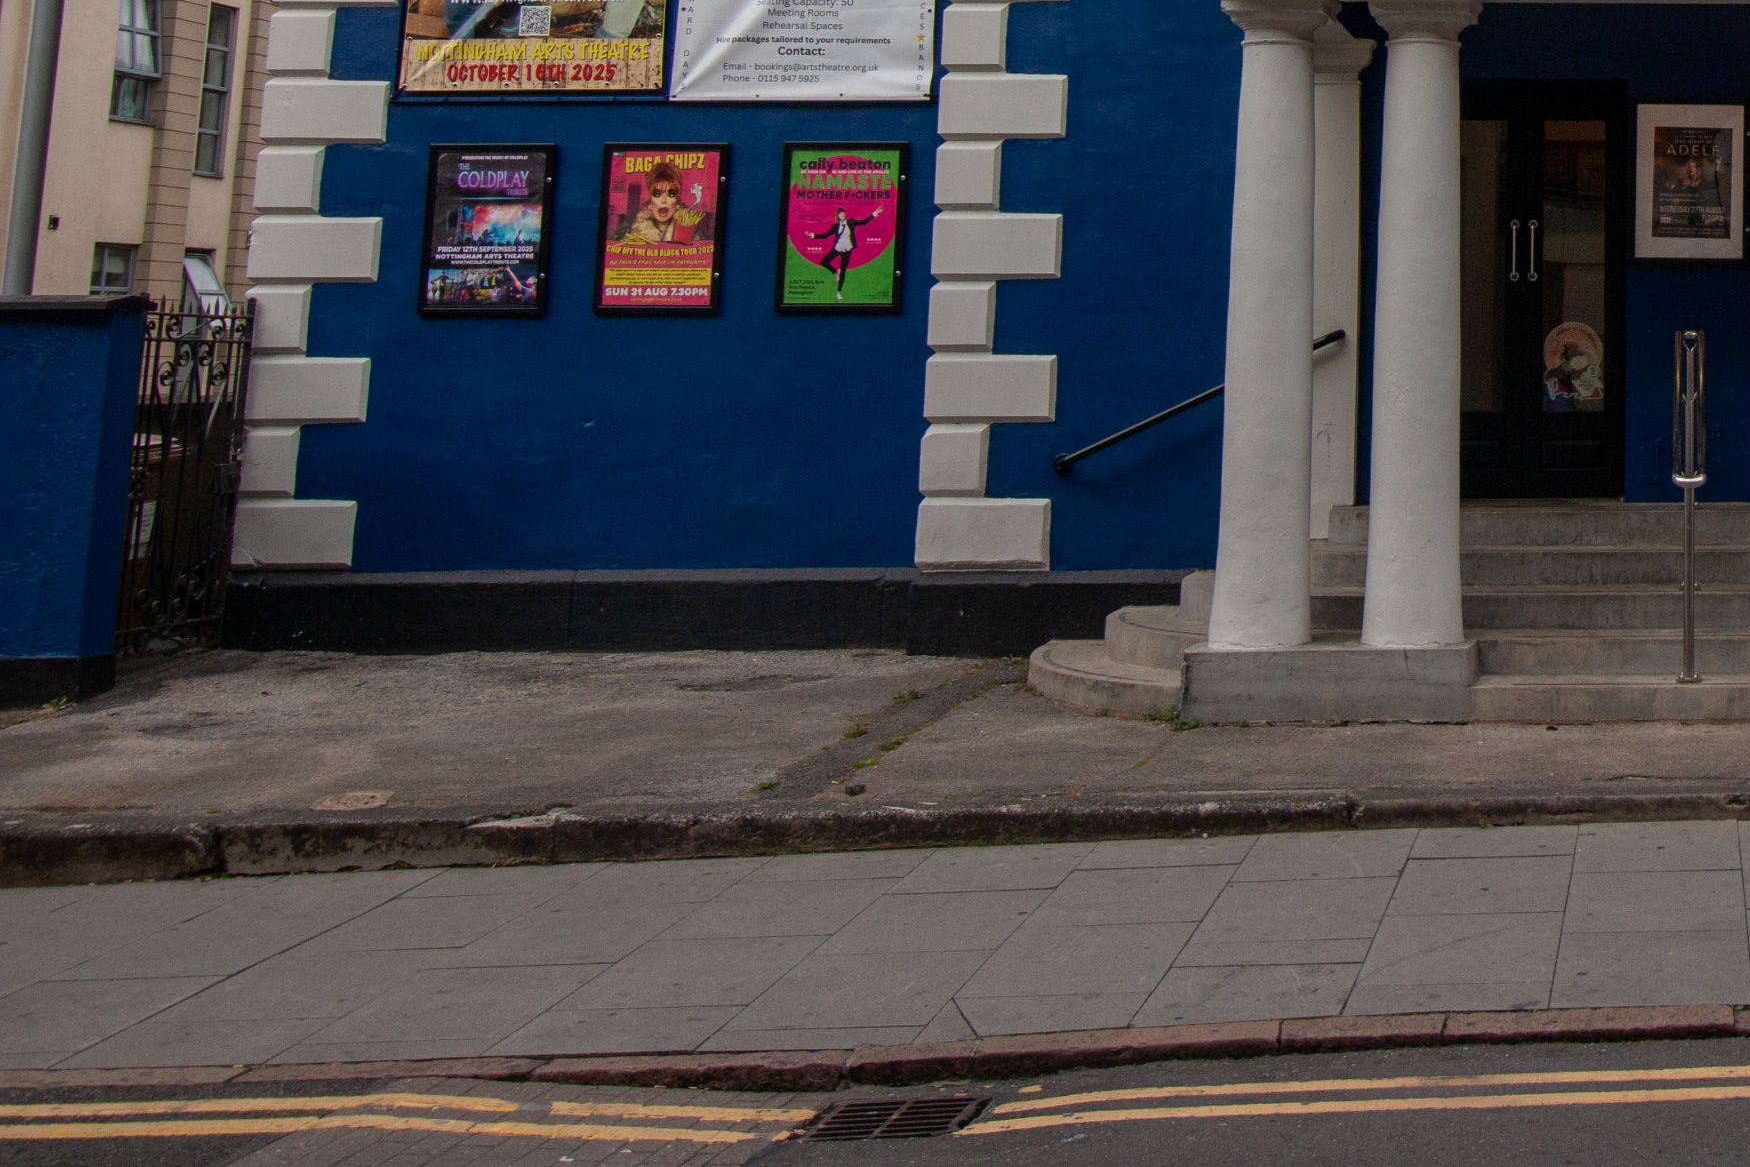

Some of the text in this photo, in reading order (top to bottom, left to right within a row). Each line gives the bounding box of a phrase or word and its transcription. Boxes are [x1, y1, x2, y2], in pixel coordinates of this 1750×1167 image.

[767, 8, 839, 19] Meeting Rooms
[762, 21, 843, 31] Rehearsal Spaces
[732, 36, 770, 46] packages
[771, 36, 804, 44] tailored
[817, 37, 835, 46] your
[836, 37, 891, 46] requirements
[416, 42, 651, 61] NOTTINGHAM ARTS THEATRE
[778, 47, 826, 56] Contact:
[447, 63, 618, 82] OCTOBER 16TH 2025
[723, 63, 879, 74] Email bookings@artstheatre.org.uk
[722, 74, 820, 83] Phone 0115 947 5925
[1667, 144, 1720, 156] ADELE
[665, 153, 705, 170] CHIPZ
[799, 158, 891, 171] cally beaton
[458, 170, 529, 188] COLDPLAY
[797, 174, 891, 190] NAMASTE
[797, 191, 842, 199] MOTHER
[606, 287, 708, 296] SUN 31 AUG 7.30PM
